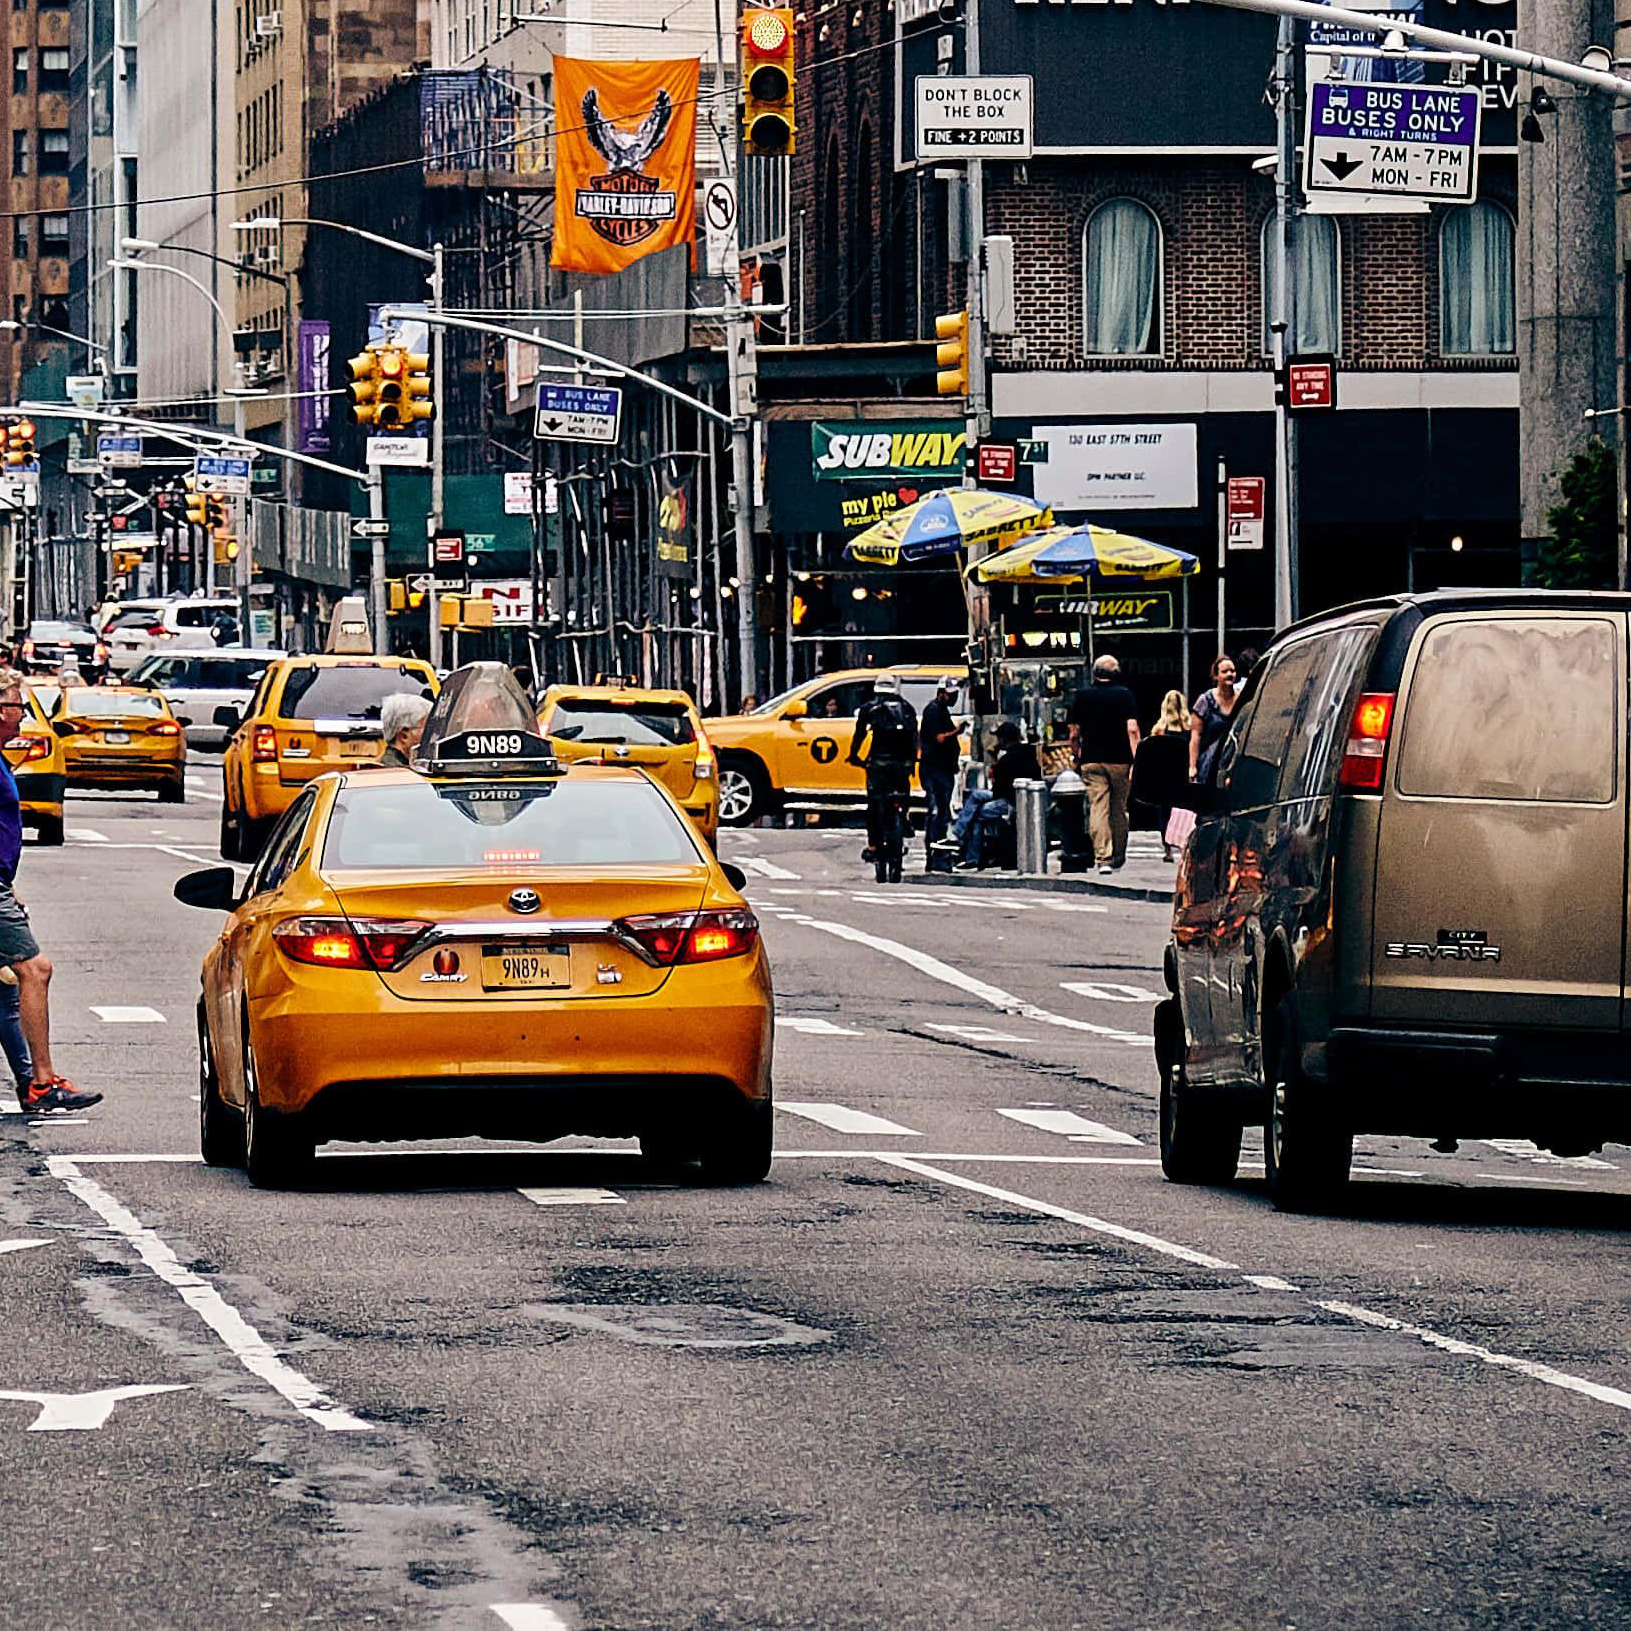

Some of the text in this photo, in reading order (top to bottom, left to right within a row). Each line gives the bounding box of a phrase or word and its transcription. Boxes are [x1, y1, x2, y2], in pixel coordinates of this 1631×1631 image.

[973, 89, 1023, 102] BLOCK
[1366, 90, 1461, 114] BUS LANE
[943, 105, 1005, 118] THE BOX
[1321, 107, 1466, 134] BUSES ONLY
[927, 130, 953, 143] FINE
[980, 130, 1021, 143] POINTS
[1361, 128, 1395, 139] RIGHT
[1400, 131, 1438, 142] TURNS
[1370, 168, 1410, 185] MON
[1429, 170, 1459, 188] FRI
[817, 432, 969, 470] SUBWAY
[841, 496, 869, 517] my
[872, 490, 898, 512] pie
[466, 735, 522, 754] 9N89
